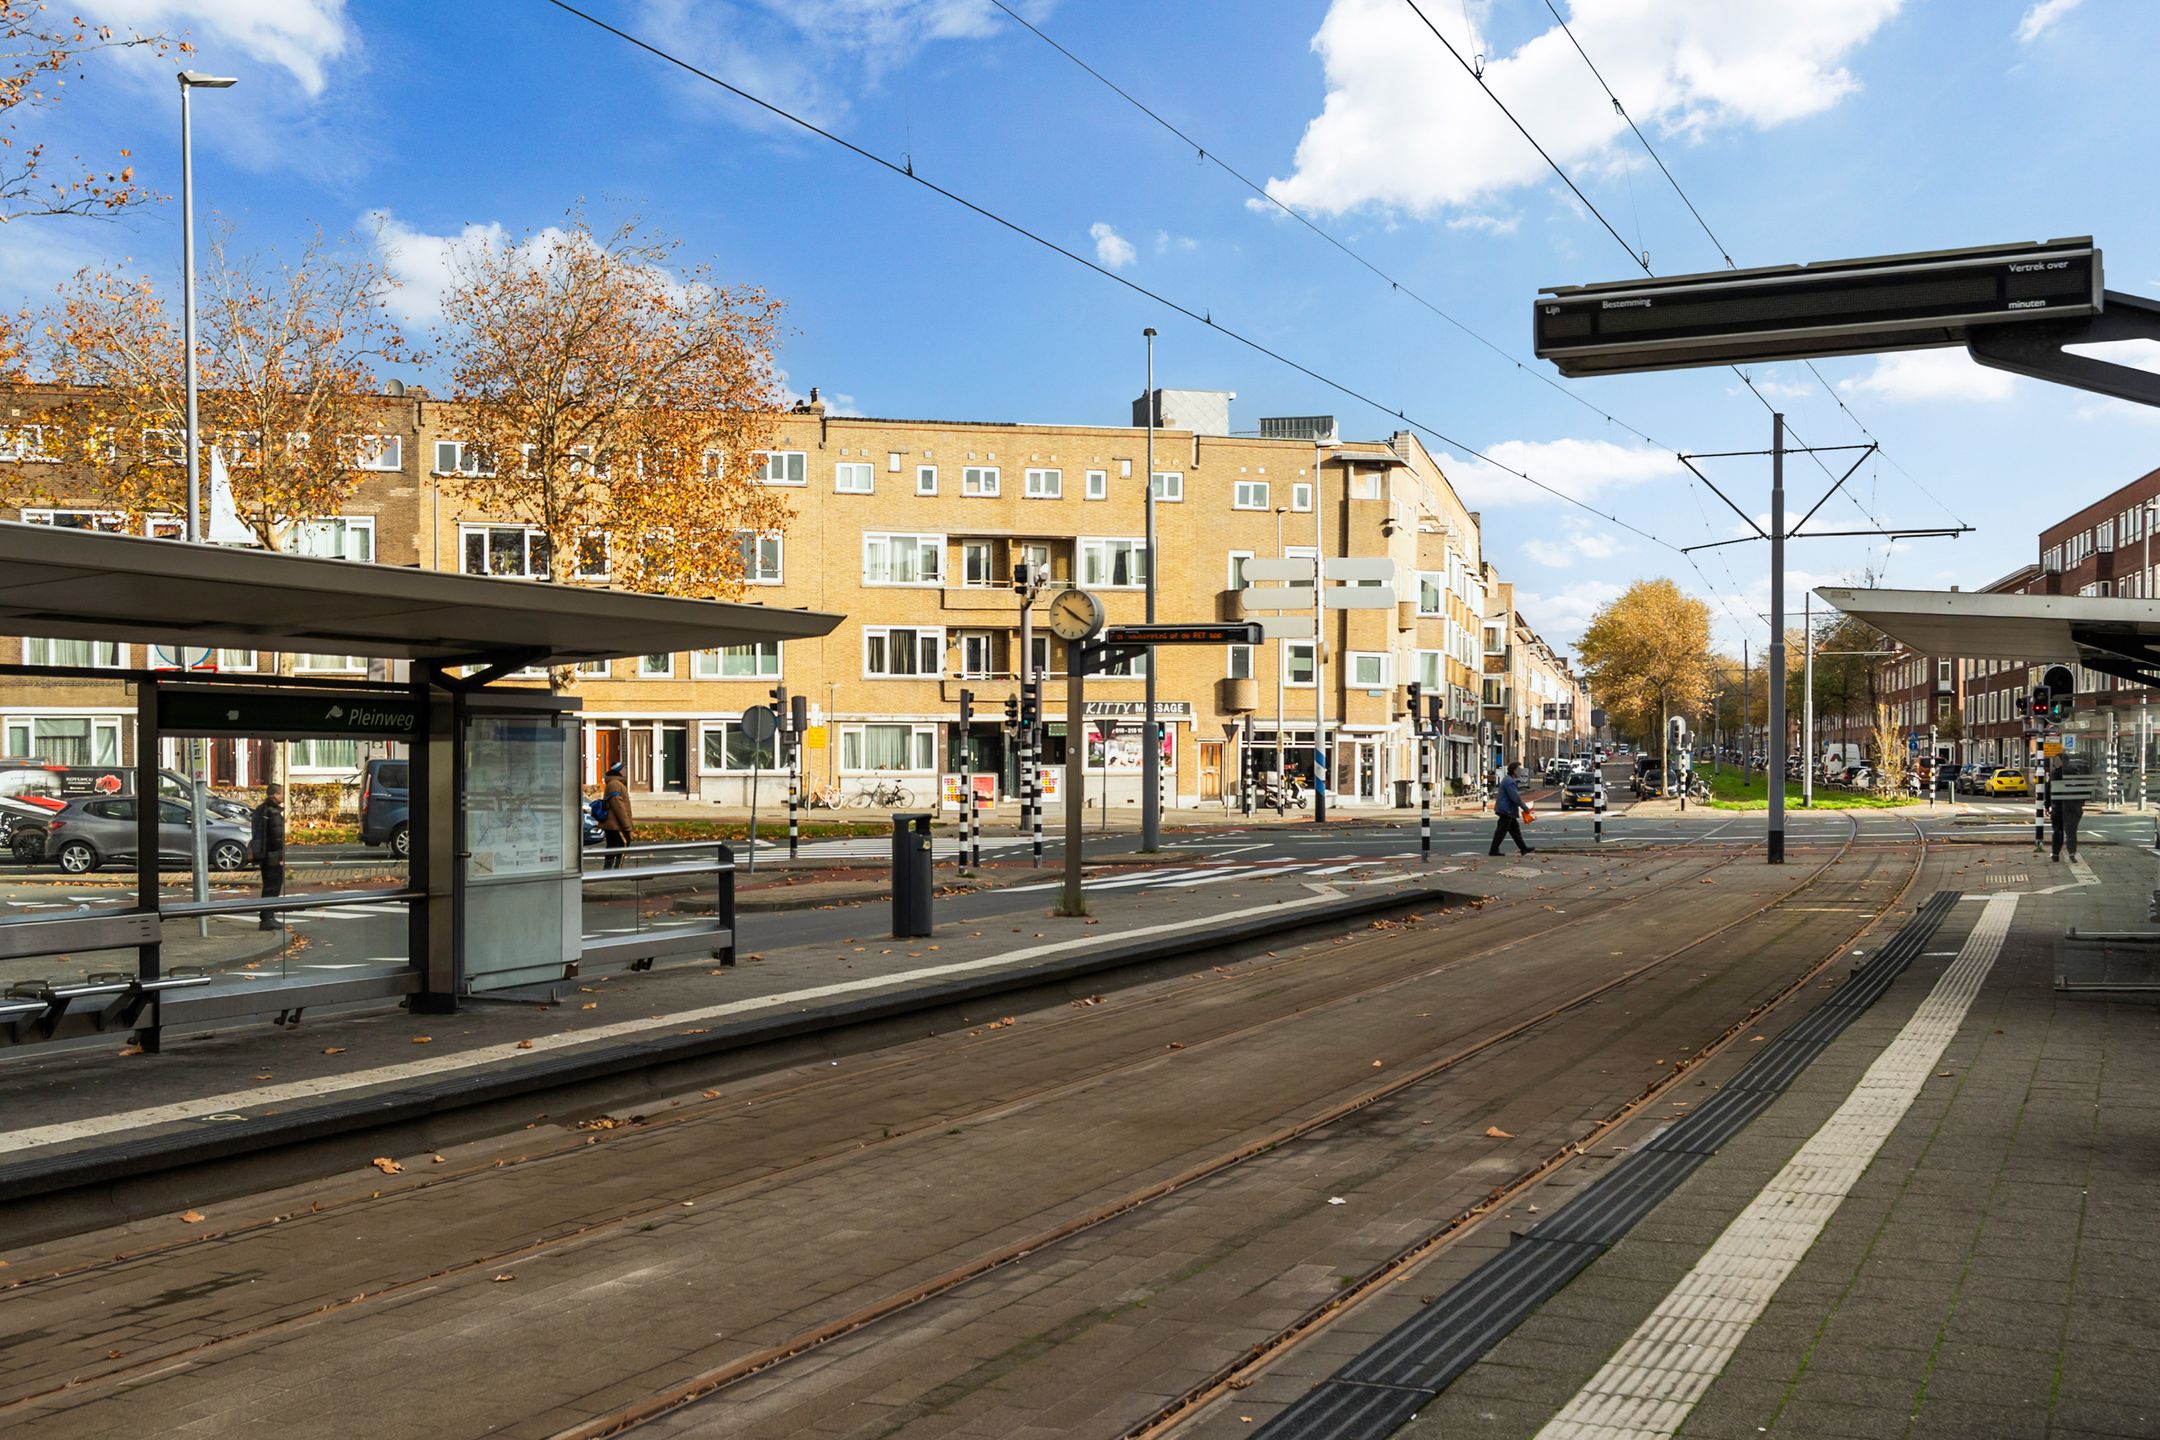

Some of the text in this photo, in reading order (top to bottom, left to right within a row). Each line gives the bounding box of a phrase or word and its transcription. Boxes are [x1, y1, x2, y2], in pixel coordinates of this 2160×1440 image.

[2008, 261, 2069, 272] Vertrek over
[1602, 298, 1651, 309] Bestemming
[2008, 300, 2046, 309] minuten
[1545, 306, 1560, 315] Lijn
[1085, 702, 1184, 714] KITTY MSAGE
[348, 707, 414, 731] Pleinweg
